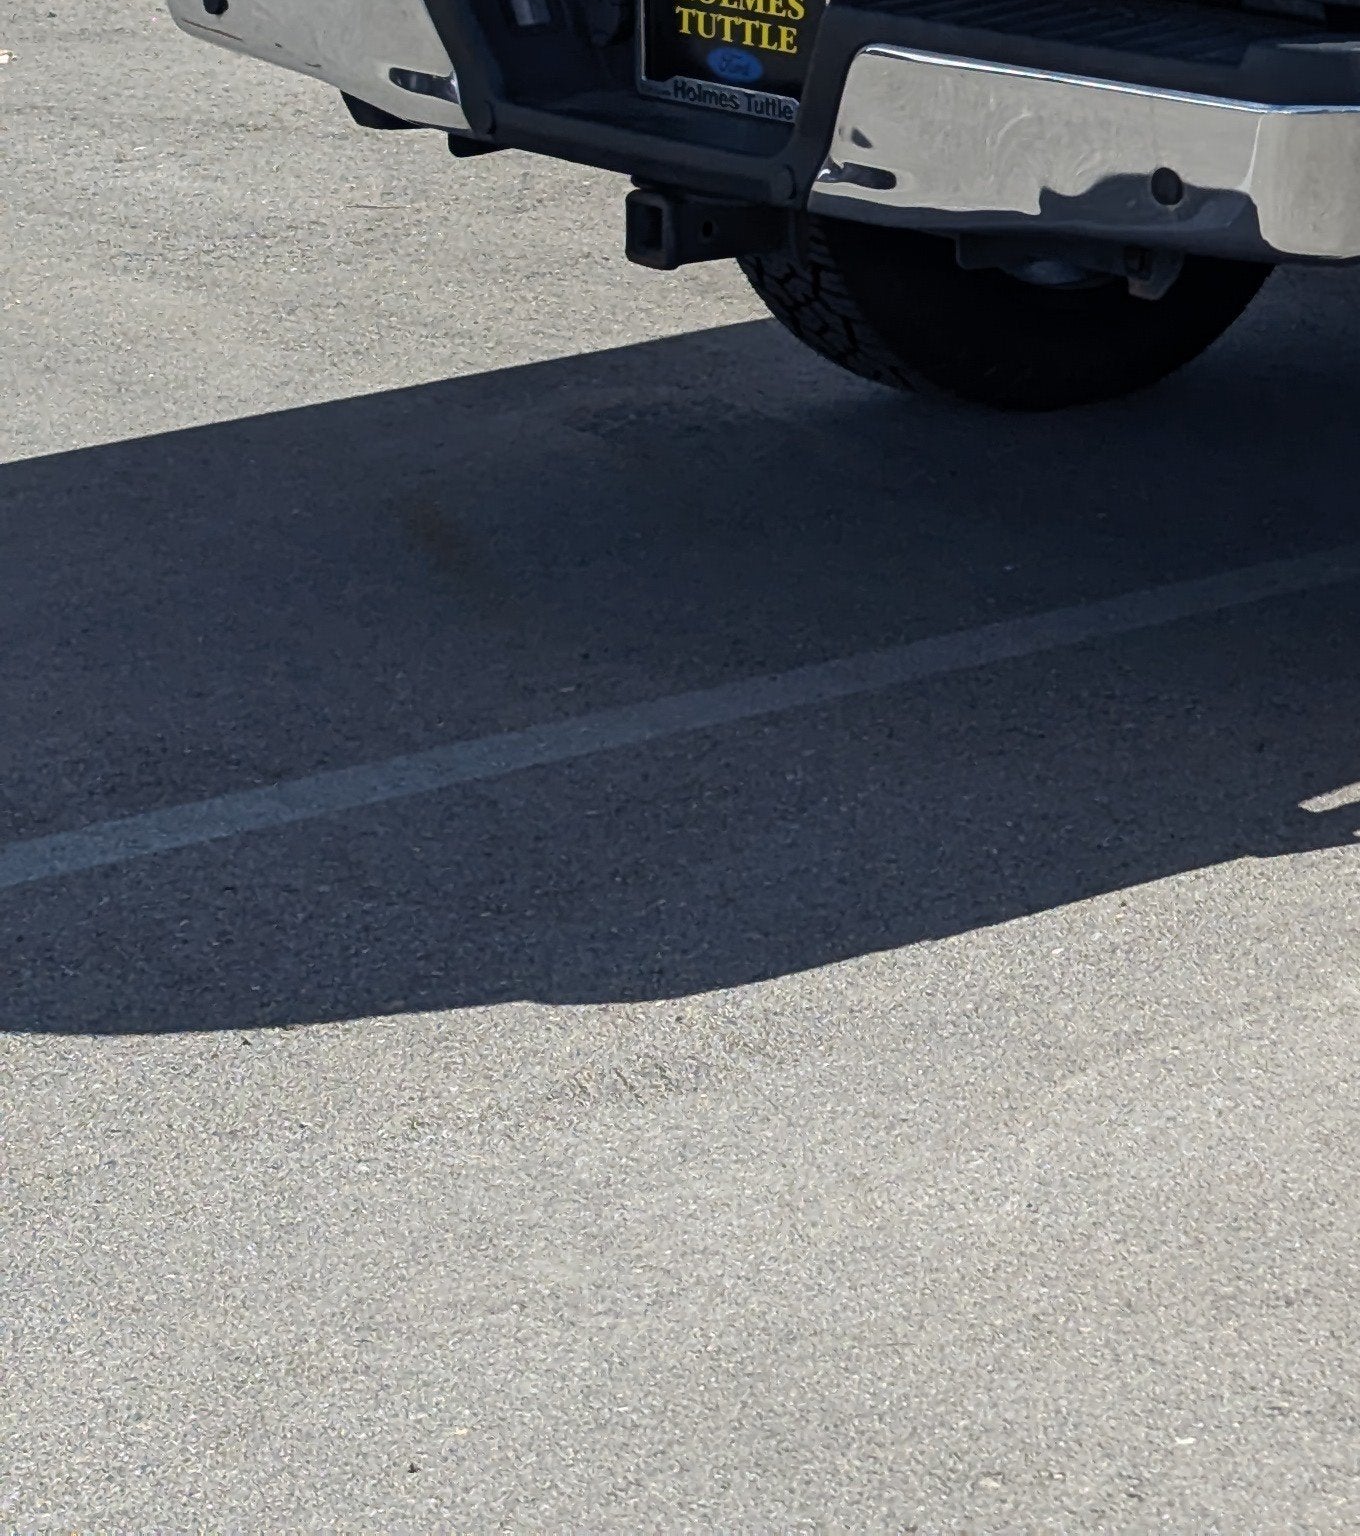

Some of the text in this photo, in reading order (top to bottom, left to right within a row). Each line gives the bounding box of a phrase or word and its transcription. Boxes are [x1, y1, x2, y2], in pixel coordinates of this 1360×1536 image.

[675, 5, 798, 54] TUTTLE
[672, 78, 795, 120] Holmes Tuttle
